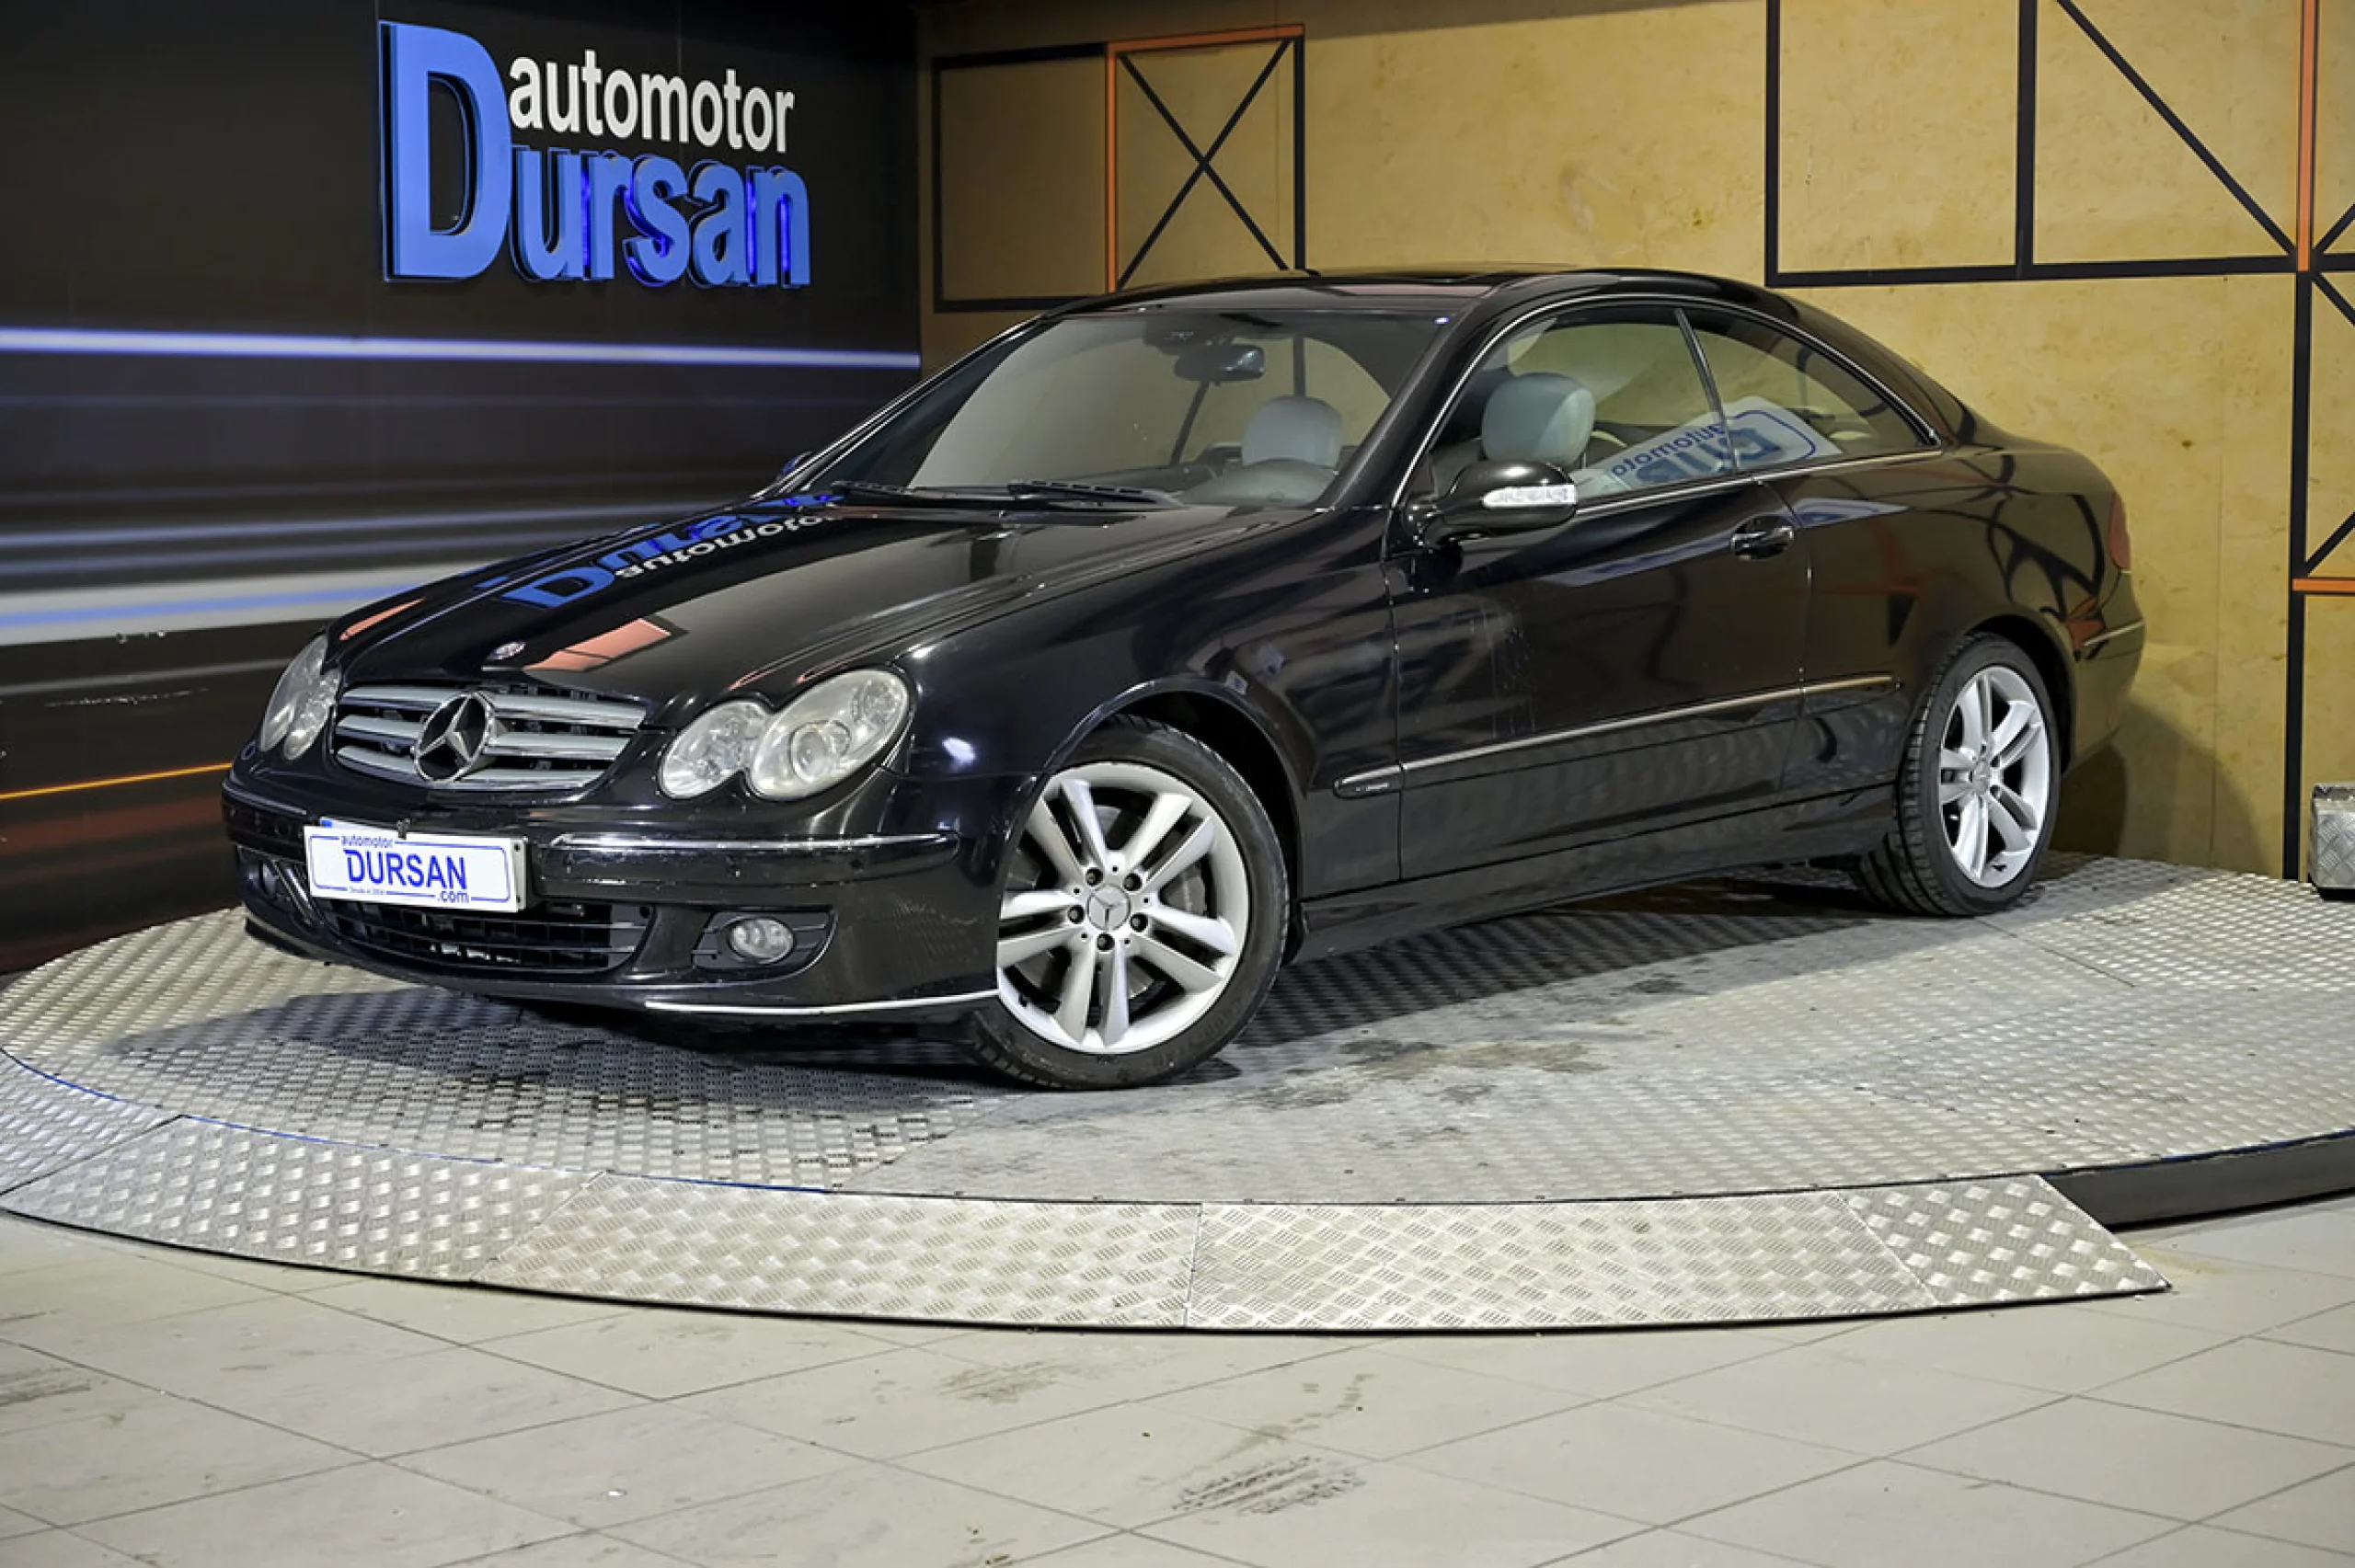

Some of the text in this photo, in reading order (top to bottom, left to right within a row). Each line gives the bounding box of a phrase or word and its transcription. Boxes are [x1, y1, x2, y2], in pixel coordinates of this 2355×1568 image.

[510, 50, 795, 153] automotor
[379, 20, 811, 287] Dursan
[341, 834, 394, 849] automotor
[343, 849, 467, 889] DURSAN
[437, 890, 470, 904] .com
